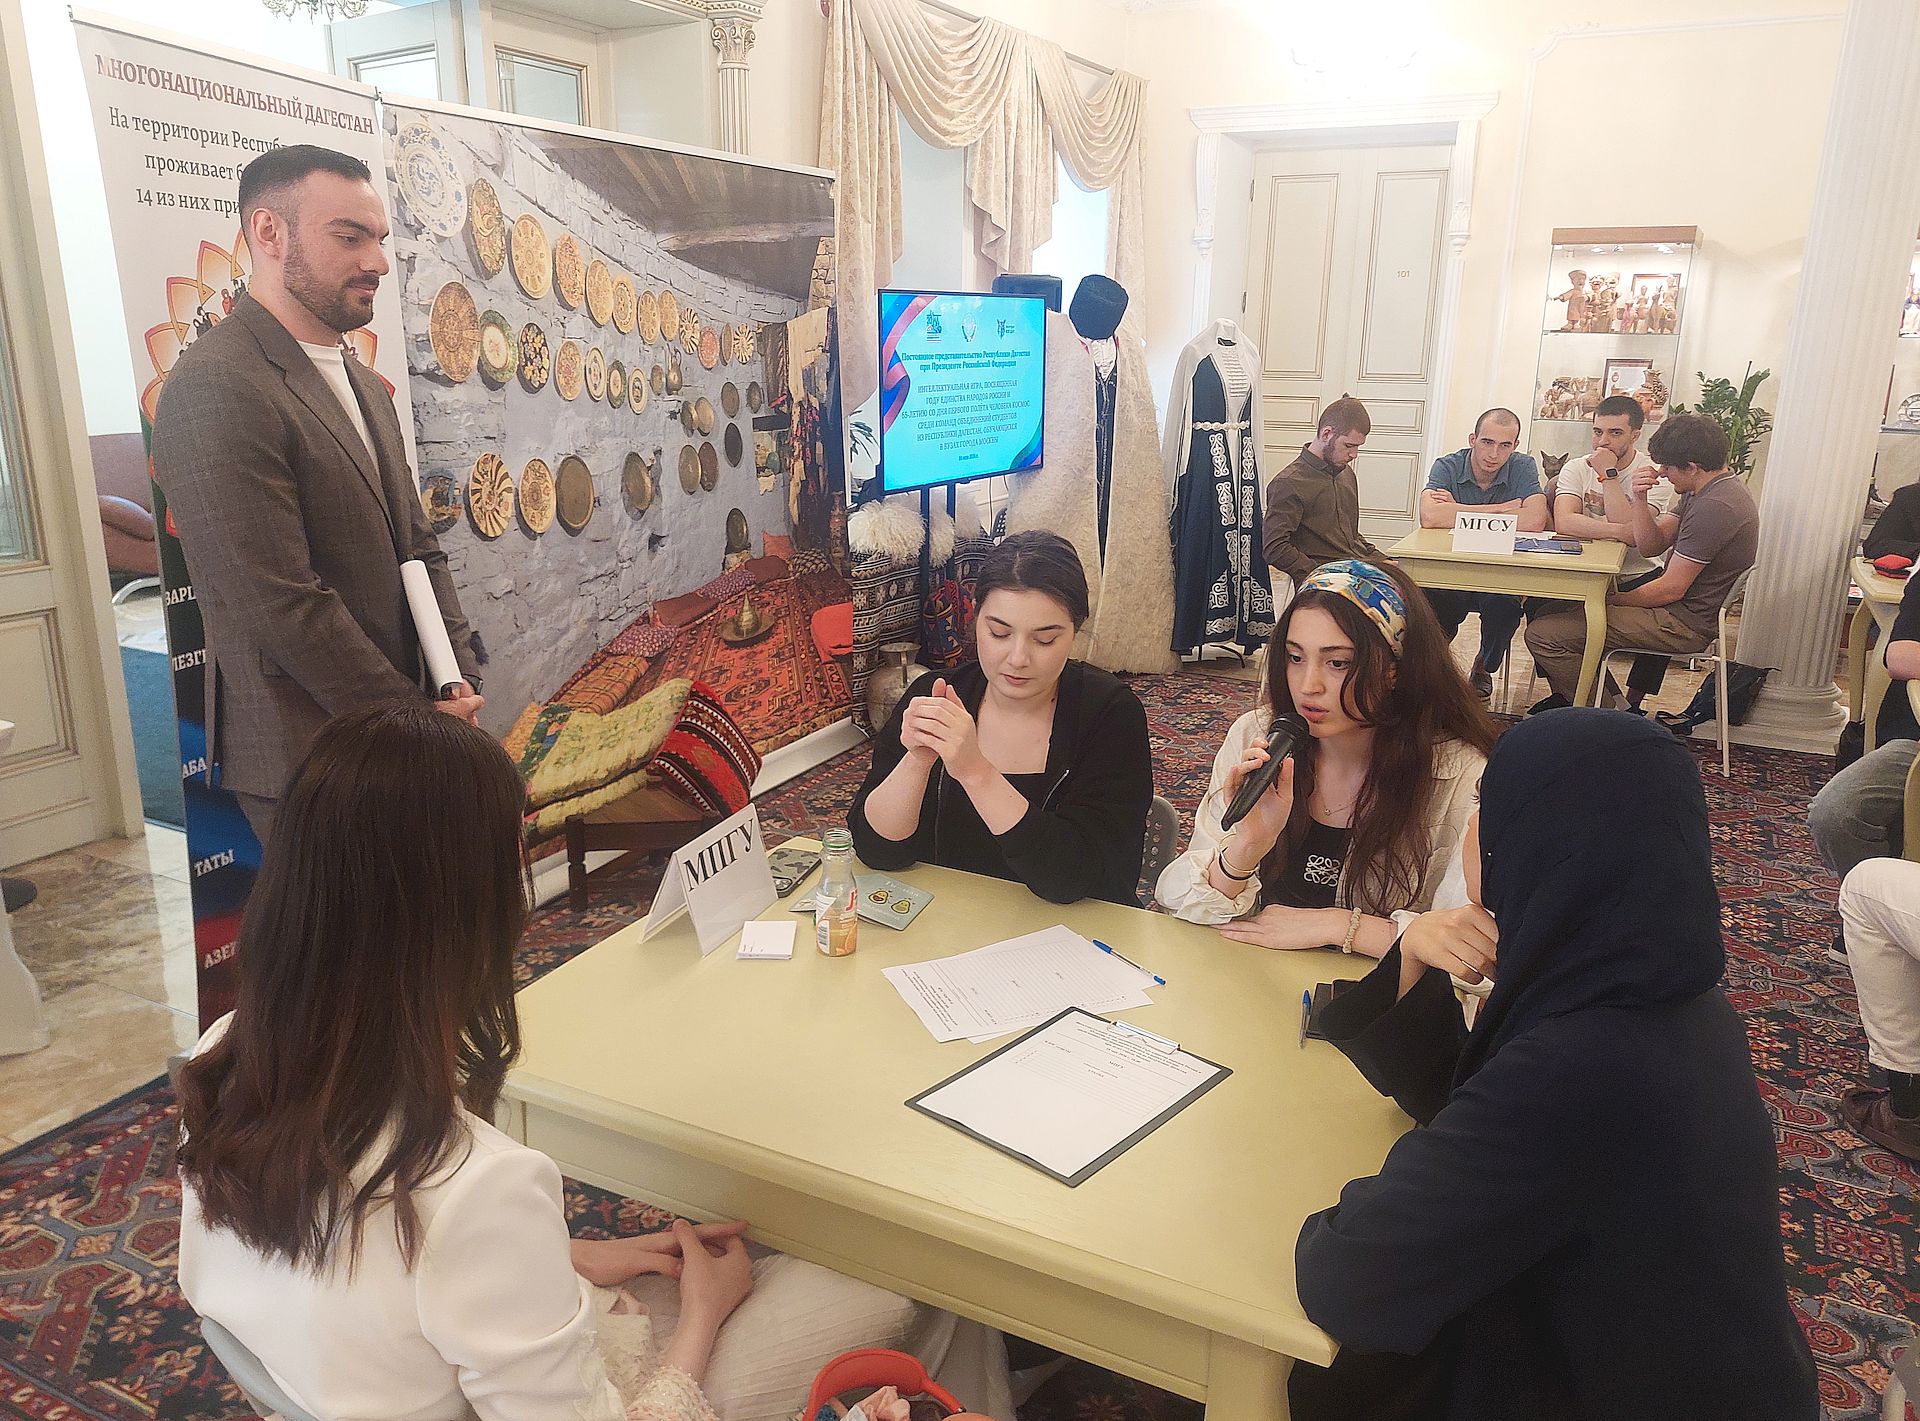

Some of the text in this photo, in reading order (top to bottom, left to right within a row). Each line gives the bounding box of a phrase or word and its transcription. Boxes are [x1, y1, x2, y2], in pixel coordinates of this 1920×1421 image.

[94, 54, 375, 135] МНОГОНАЦИОНАЛЬНЫЙ ДАГЕСТАН
[108, 106, 284, 153] На территории Респуб
[145, 154, 234, 180] проживает
[136, 188, 153, 207] 14
[156, 191, 175, 206] из
[178, 194, 211, 211] них
[1397, 270, 1410, 278] 101
[1459, 517, 1514, 532] МГСУ
[194, 849, 234, 877] ТАТЫ
[683, 818, 755, 892] МПГУ
